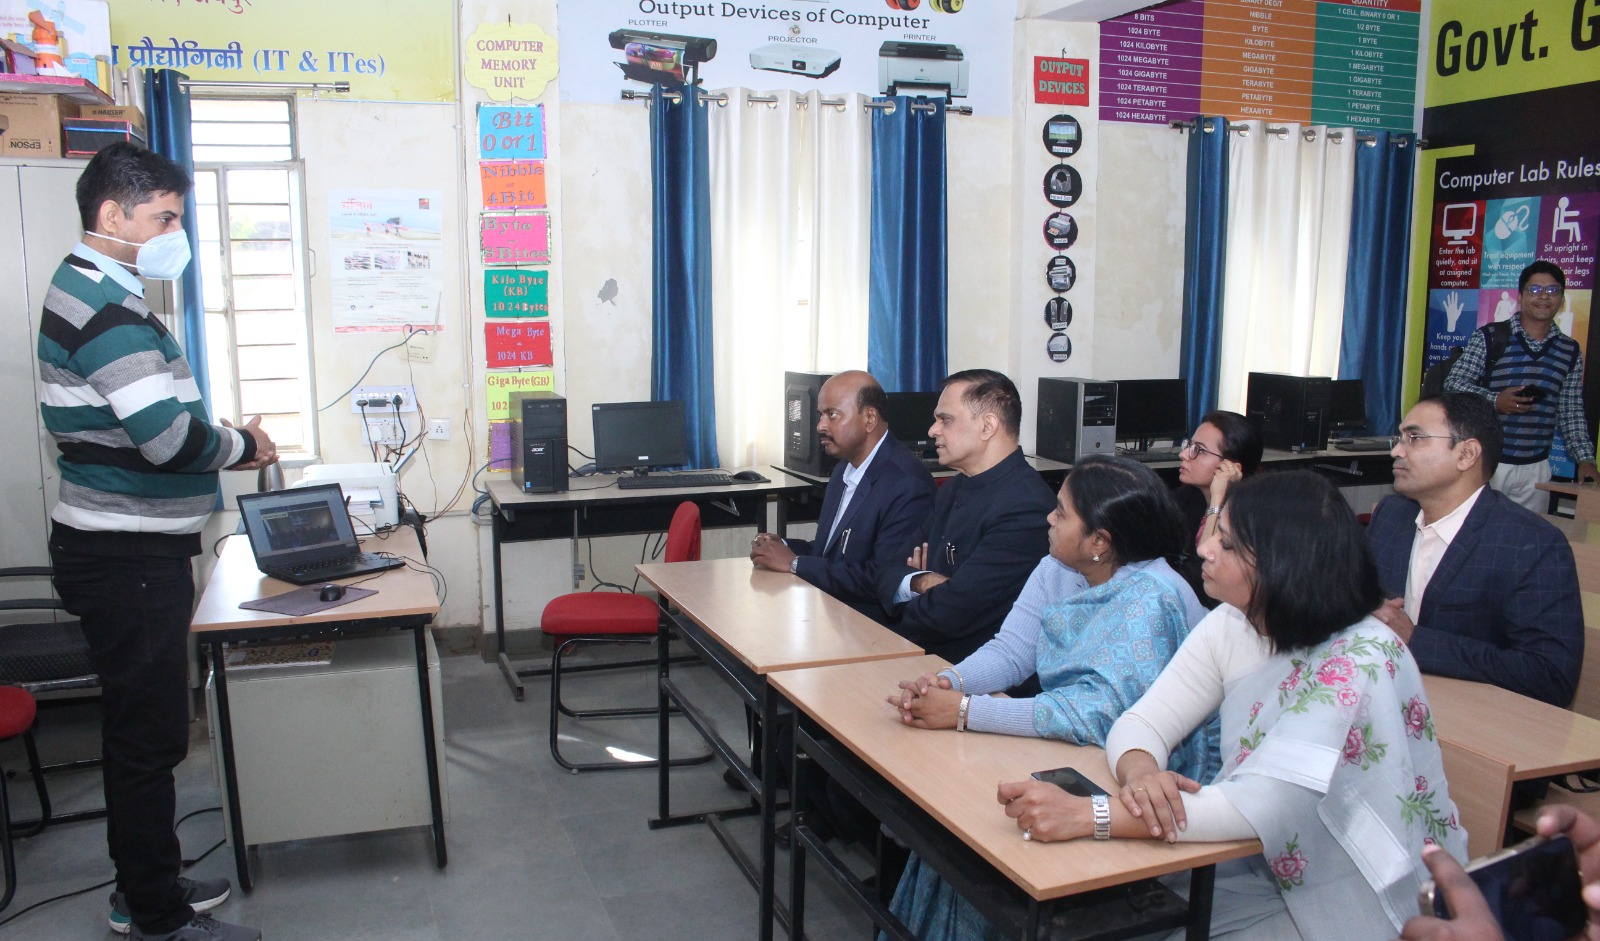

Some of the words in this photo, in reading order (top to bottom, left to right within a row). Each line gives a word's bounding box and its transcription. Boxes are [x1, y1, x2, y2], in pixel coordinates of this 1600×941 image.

[639, 0, 715, 18] Output
[721, 2, 800, 21] Devices
[806, 8, 827, 22] of
[831, 10, 930, 30] Computer
[1140, 14, 1155, 22] BITS
[1250, 11, 1273, 20] NIBBLE
[628, 19, 668, 27] PLOTTER
[1144, 28, 1160, 36] BYTE
[1252, 25, 1268, 33] BYTE
[768, 35, 818, 44] PROJECTOR
[904, 34, 936, 42] PRINTER
[476, 40, 544, 53] COMPUTER
[1136, 42, 1168, 51] KILOBYTE
[1244, 38, 1275, 48] KILOBYTE
[1436, 10, 1549, 77] Govt.
[128, 36, 244, 70] प्रौद्योगिकी
[253, 49, 290, 76] (IT
[298, 50, 319, 73] &
[327, 50, 386, 78] ITes)
[1242, 52, 1276, 61] MEGABYTE
[1355, 50, 1384, 58] KILOBYTE
[480, 58, 538, 70] MEMORY
[1132, 56, 1169, 66] MEGABYTE
[1040, 60, 1084, 76] OUTPUT
[1243, 66, 1275, 74] GIGABYTE
[1352, 64, 1384, 72] MEGABYTE
[1134, 70, 1168, 80] GIGABYTE
[494, 76, 526, 88] UNIT
[1242, 79, 1274, 88] TERABYTE
[1353, 76, 1382, 84] GIGABYTE
[1039, 80, 1085, 94] DEVICES
[1132, 84, 1168, 94] TERABYTE
[1242, 92, 1273, 102] PETABYTE
[1352, 90, 1382, 98] TERABYTE
[1132, 98, 1166, 108] PETABYTE
[1352, 102, 1380, 110] PETABYTE
[1240, 106, 1272, 116] HEXABYTE
[492, 110, 534, 130] Bit
[1132, 112, 1166, 121] HEXABYTE
[1350, 116, 1380, 124] HEXABYTE
[10, 141, 41, 150] EPSON
[482, 134, 497, 152] 0
[502, 135, 524, 150] or
[526, 133, 537, 150] 1
[482, 164, 544, 178] Nibble
[1440, 170, 1514, 192] Computer
[1520, 161, 1550, 182] Lab
[1556, 156, 1600, 180] Rules
[482, 216, 532, 234] Byte
[1466, 246, 1476, 254] lab
[1544, 244, 1553, 252] Sit
[1554, 244, 1580, 253] upright
[1500, 252, 1534, 260] equipment
[1576, 255, 1594, 264] keep
[1436, 258, 1456, 267] quietly,
[1502, 263, 1526, 271] respect
[1446, 269, 1472, 278] assigned
[1575, 267, 1590, 276] legs
[492, 276, 516, 284] Kilo
[519, 274, 544, 286] Byte
[1441, 280, 1469, 288] computer.
[504, 286, 529, 296] (KB)
[496, 326, 522, 338] Mega
[526, 327, 544, 340] Byte
[1436, 332, 1452, 342] Keep
[1430, 342, 1447, 350] hands
[497, 352, 517, 360] 1024
[520, 352, 534, 360] KB
[488, 376, 510, 388] Giga
